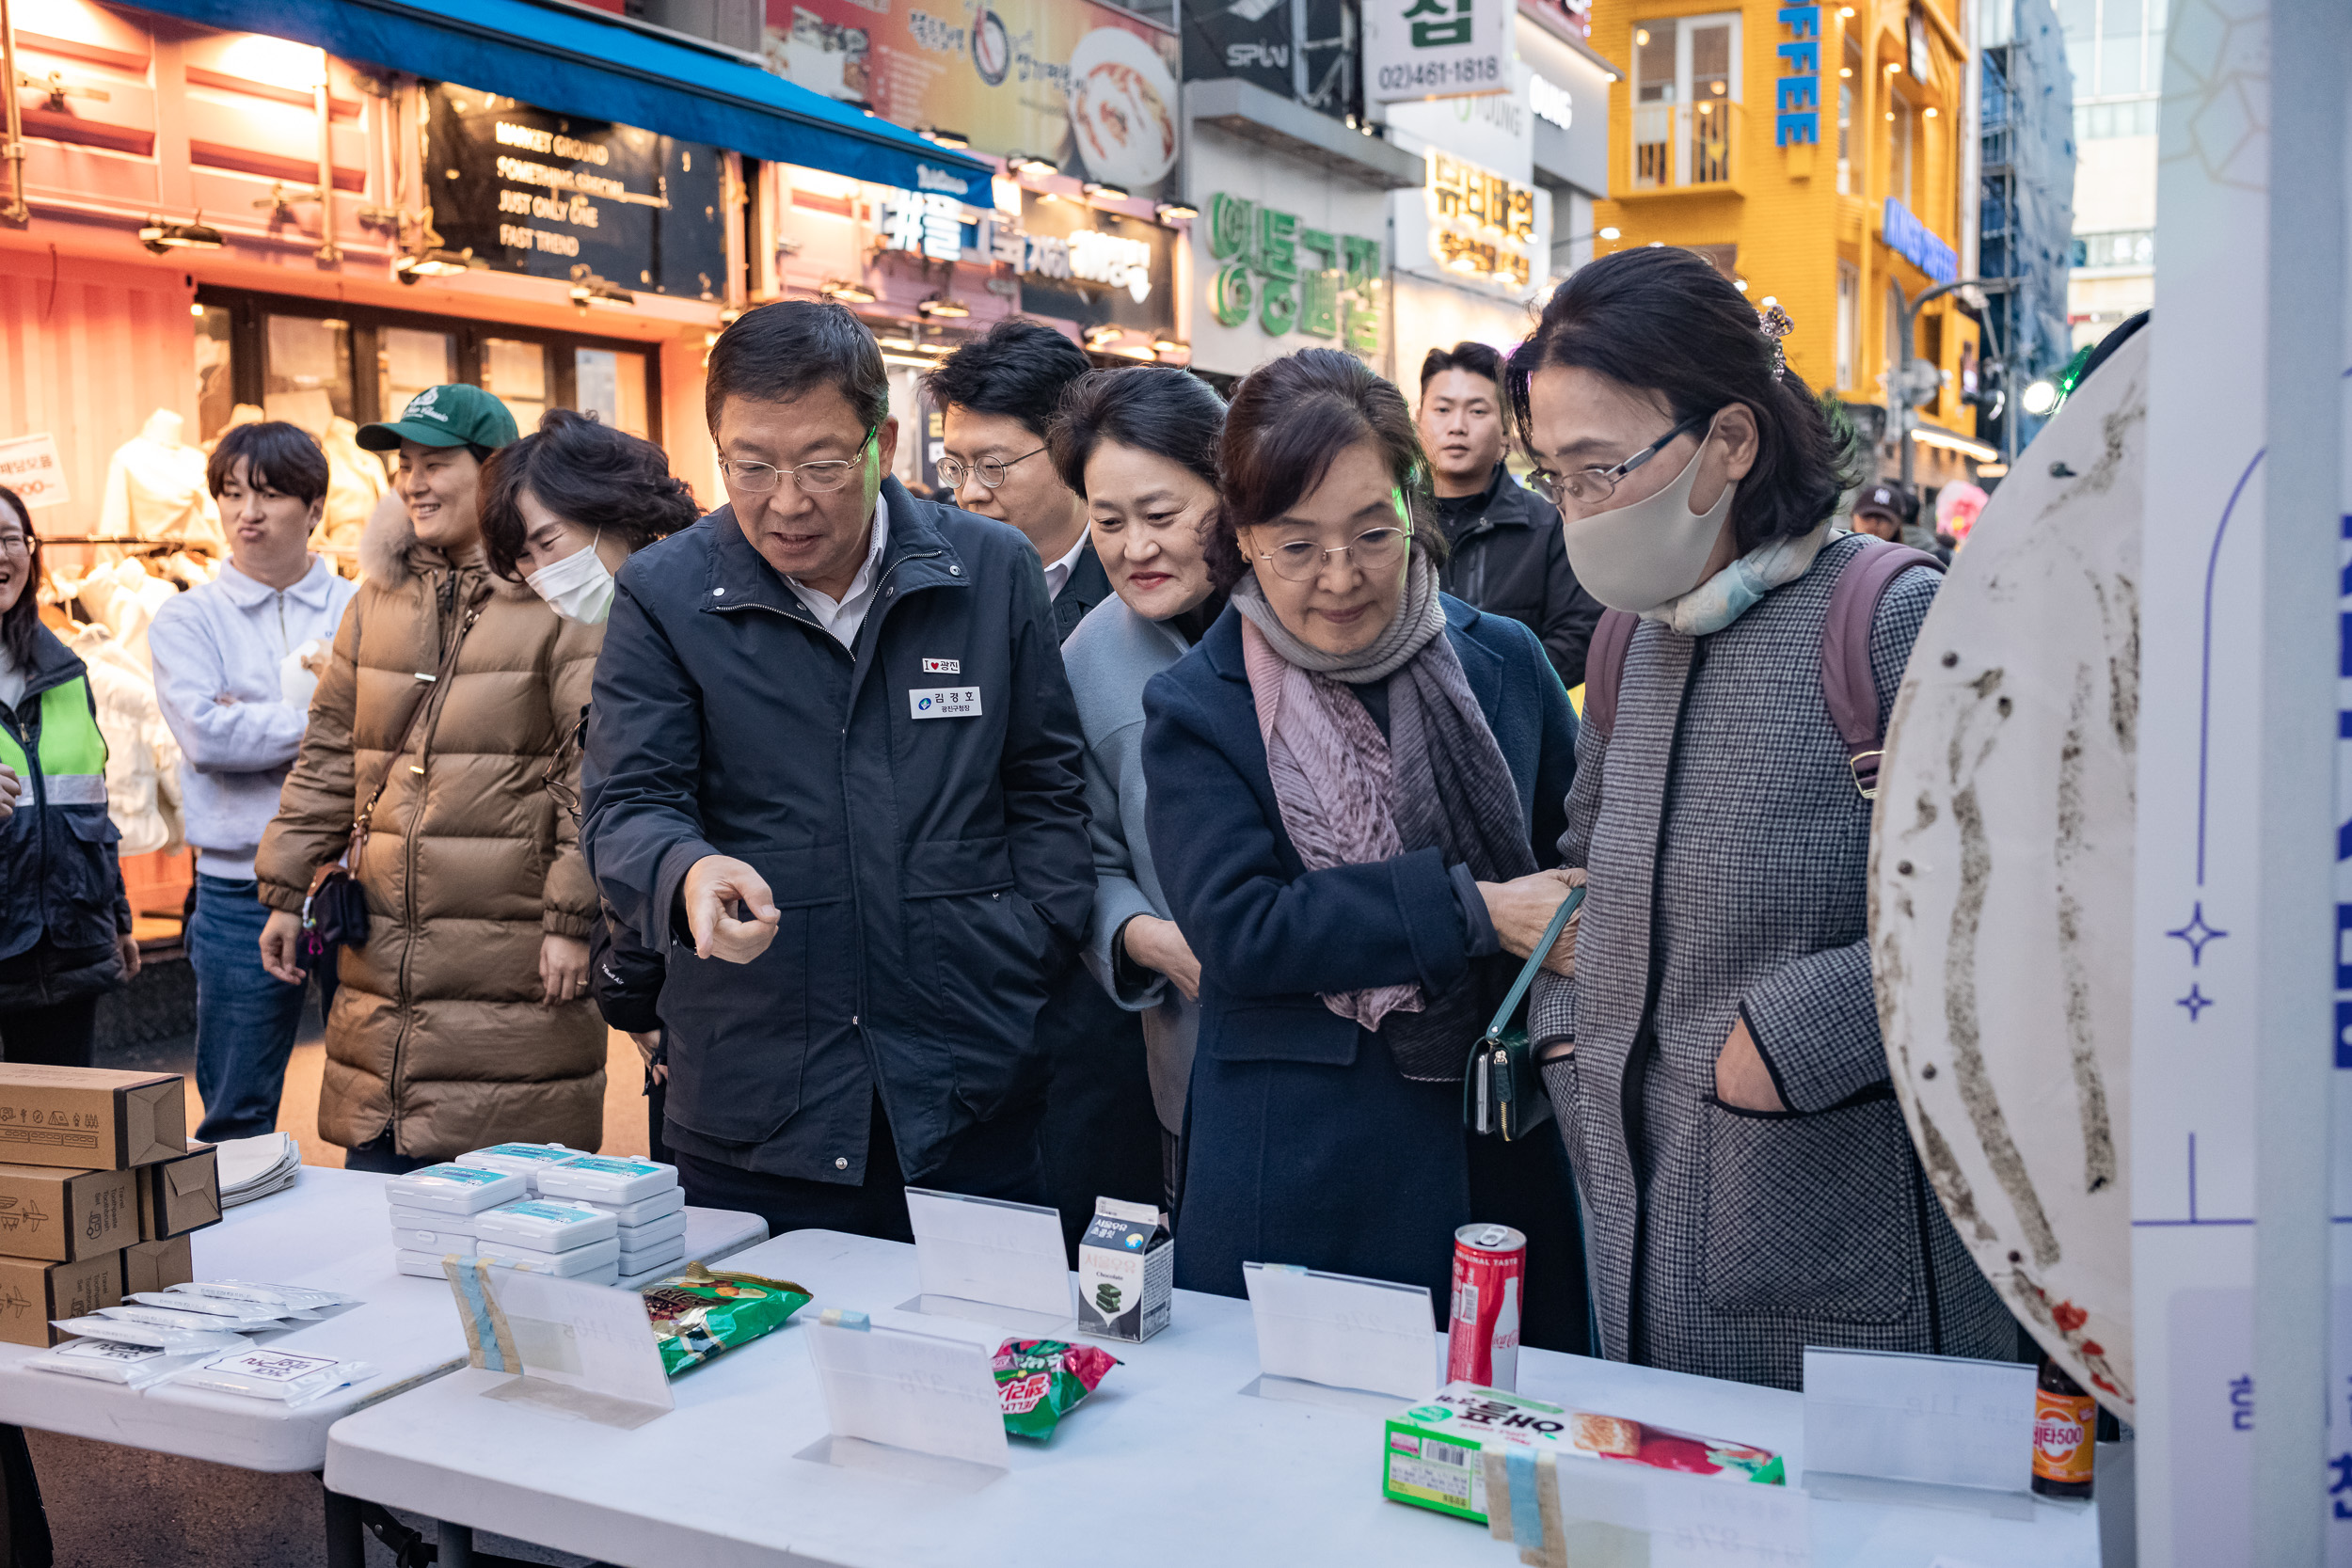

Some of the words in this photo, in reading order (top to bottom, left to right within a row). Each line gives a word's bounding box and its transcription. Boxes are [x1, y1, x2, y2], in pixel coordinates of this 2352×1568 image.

[1378, 56, 1499, 90] 02)461-1818
[1775, 0, 1820, 147] FFEE
[496, 120, 553, 153] MARKET
[553, 135, 609, 166] GROUND
[497, 155, 575, 189] SOMETHING
[499, 189, 532, 214] JUST
[532, 196, 568, 222] ONLY
[500, 224, 534, 249] FAST
[534, 230, 580, 258] TREND
[925, 660, 930, 670] I
[941, 661, 958, 672] 광진
[942, 705, 970, 713] 광진구청장
[1090, 1227, 1116, 1239] 초콜릿
[1095, 1219, 1128, 1231] 서울우유
[1085, 1254, 1136, 1275] 서울우유
[1455, 1248, 1490, 1266] ORIGINAL
[1493, 1258, 1518, 1266] TASTE
[1096, 1272, 1123, 1281] Chocolate
